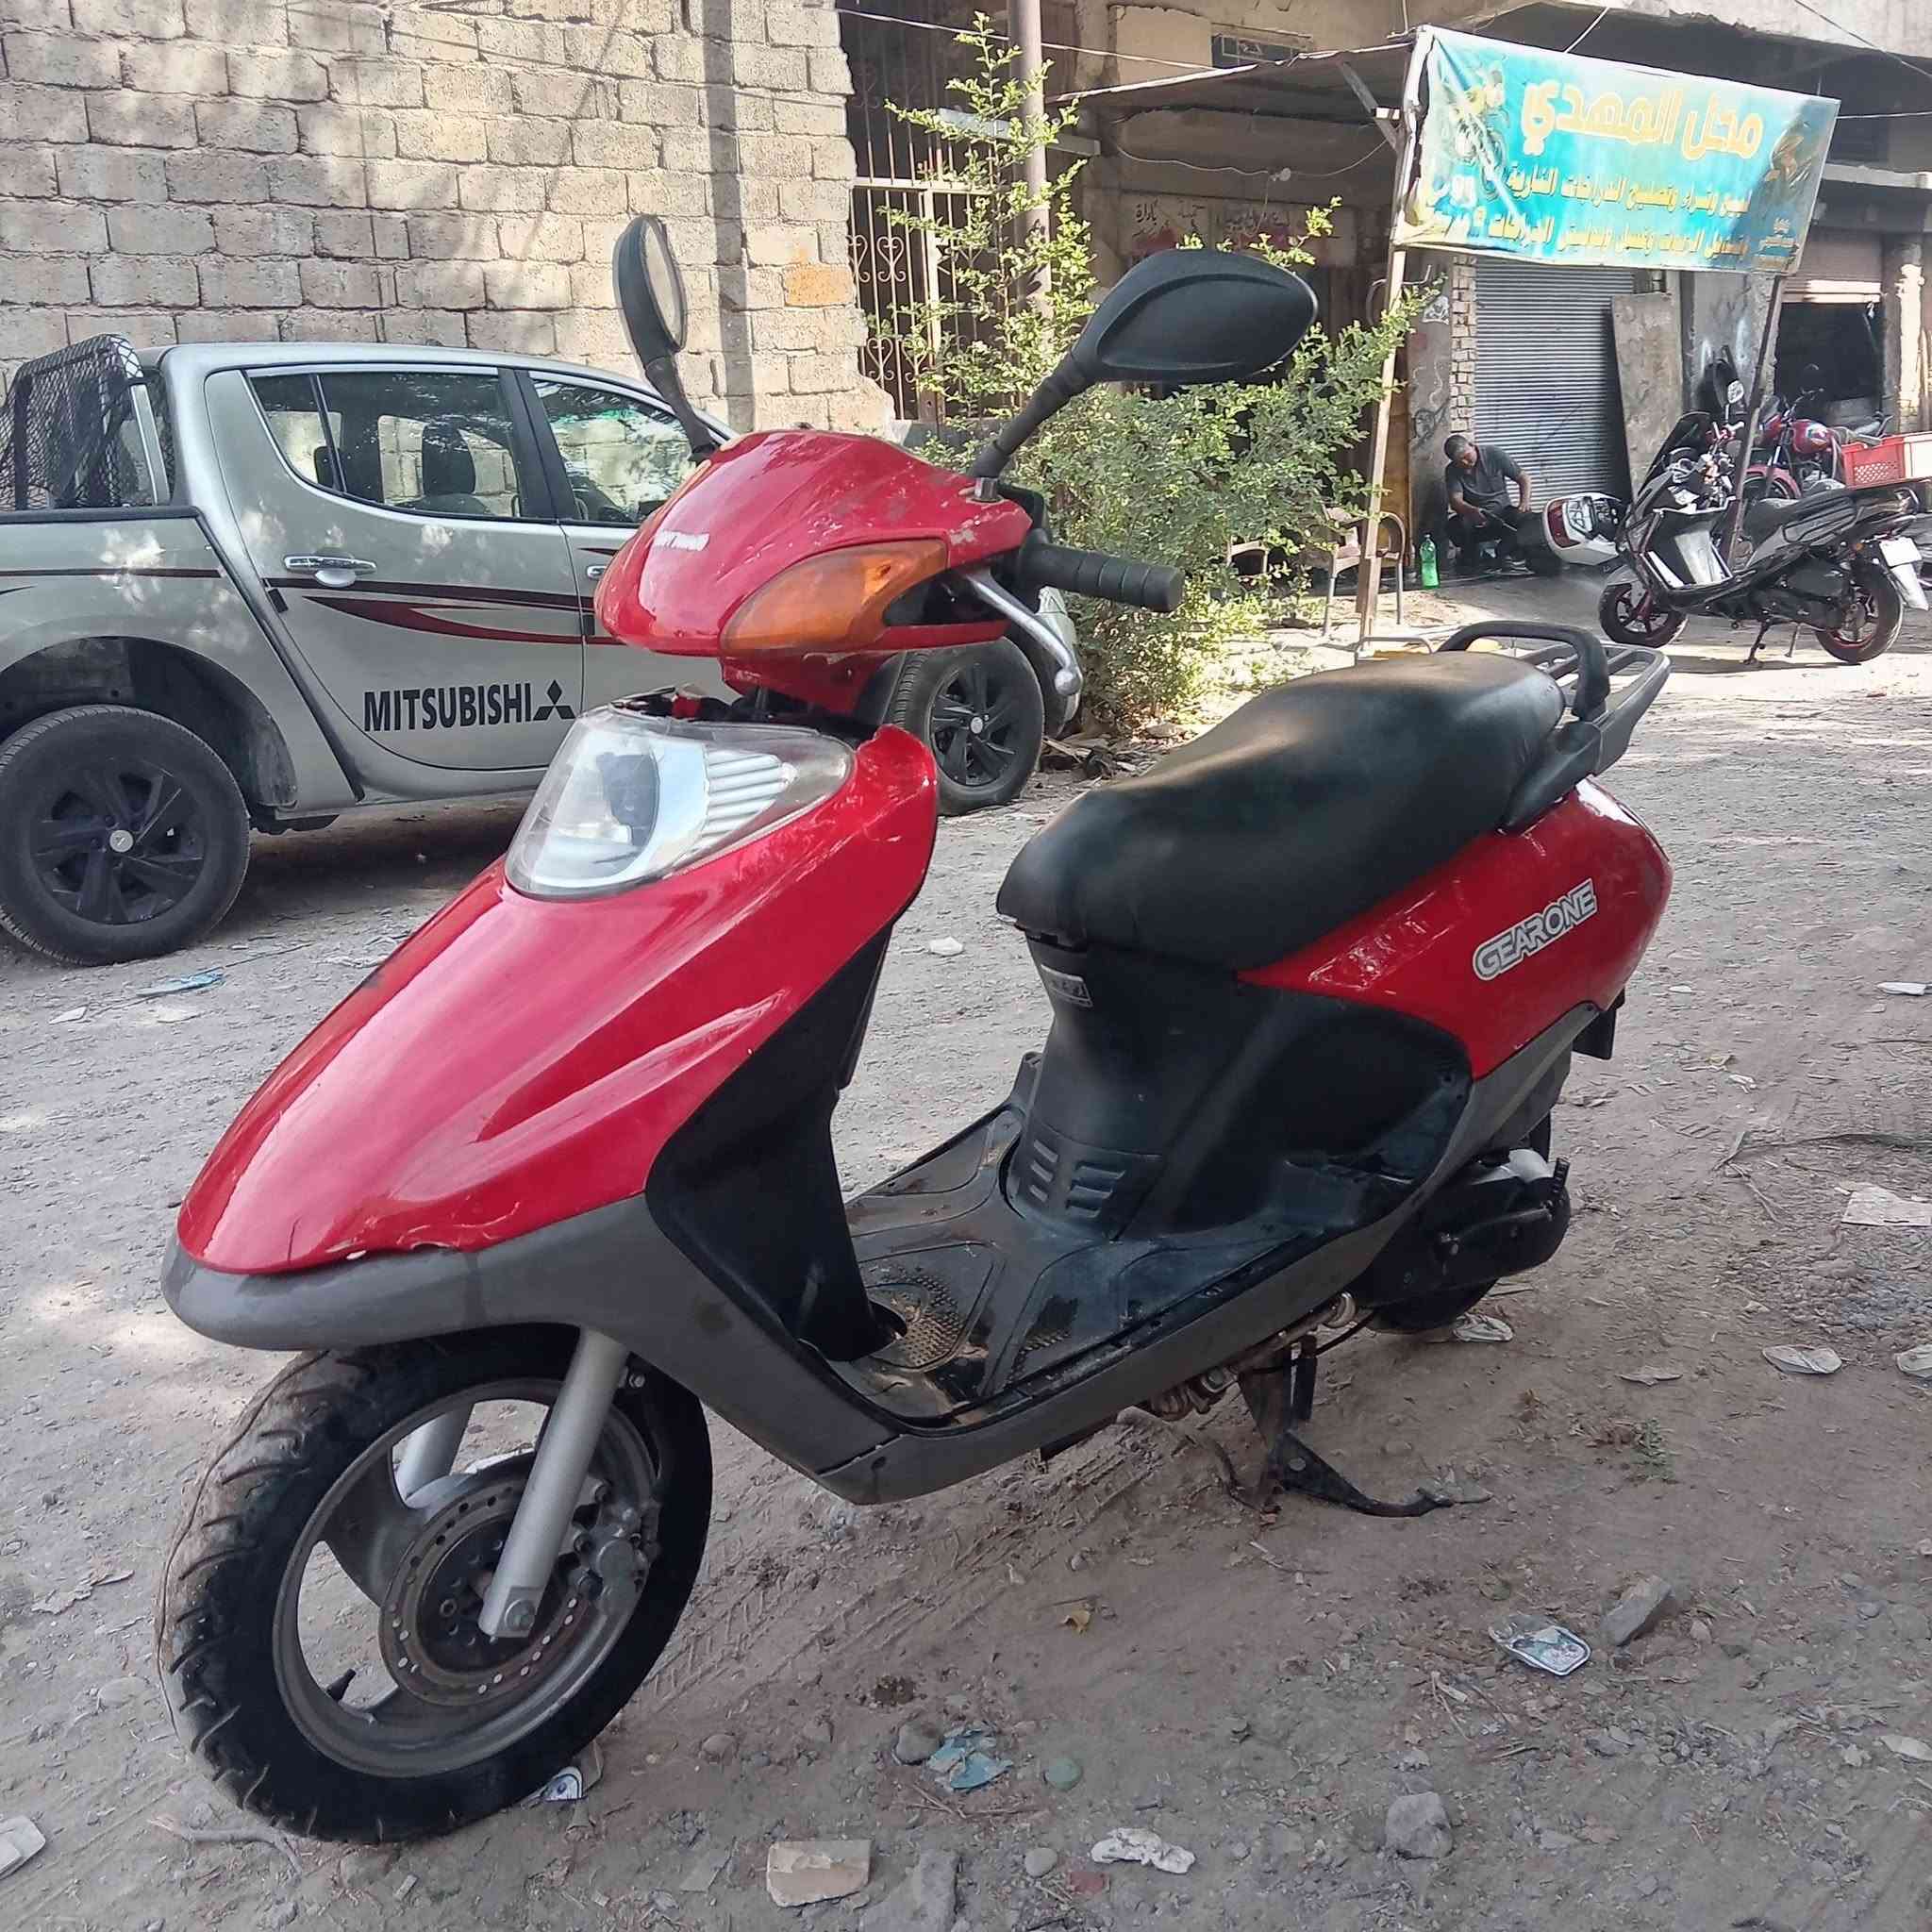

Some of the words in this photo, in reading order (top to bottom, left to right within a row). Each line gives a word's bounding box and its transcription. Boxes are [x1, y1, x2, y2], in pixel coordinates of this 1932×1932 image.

[1521, 80, 1682, 156] المهدي
[1682, 92, 1763, 160] محل
[364, 682, 532, 732] MITSUBISHI
[1473, 878, 1598, 980] GEARONE
